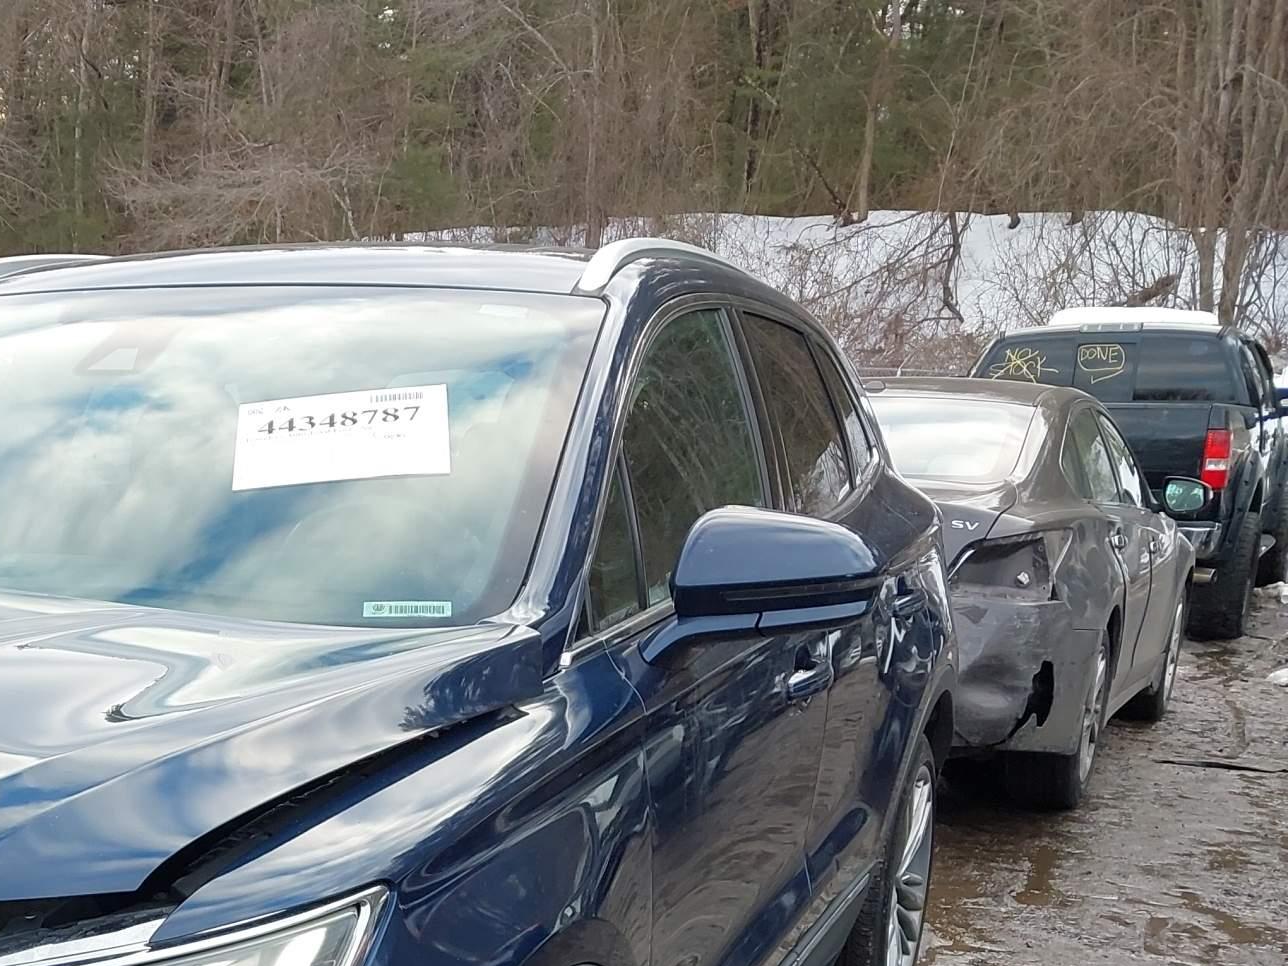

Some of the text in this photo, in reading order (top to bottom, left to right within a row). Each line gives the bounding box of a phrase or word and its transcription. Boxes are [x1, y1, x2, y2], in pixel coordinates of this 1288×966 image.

[1080, 347, 1119, 363] DONE
[257, 406, 421, 435] 44348787
[951, 520, 979, 530] SV
